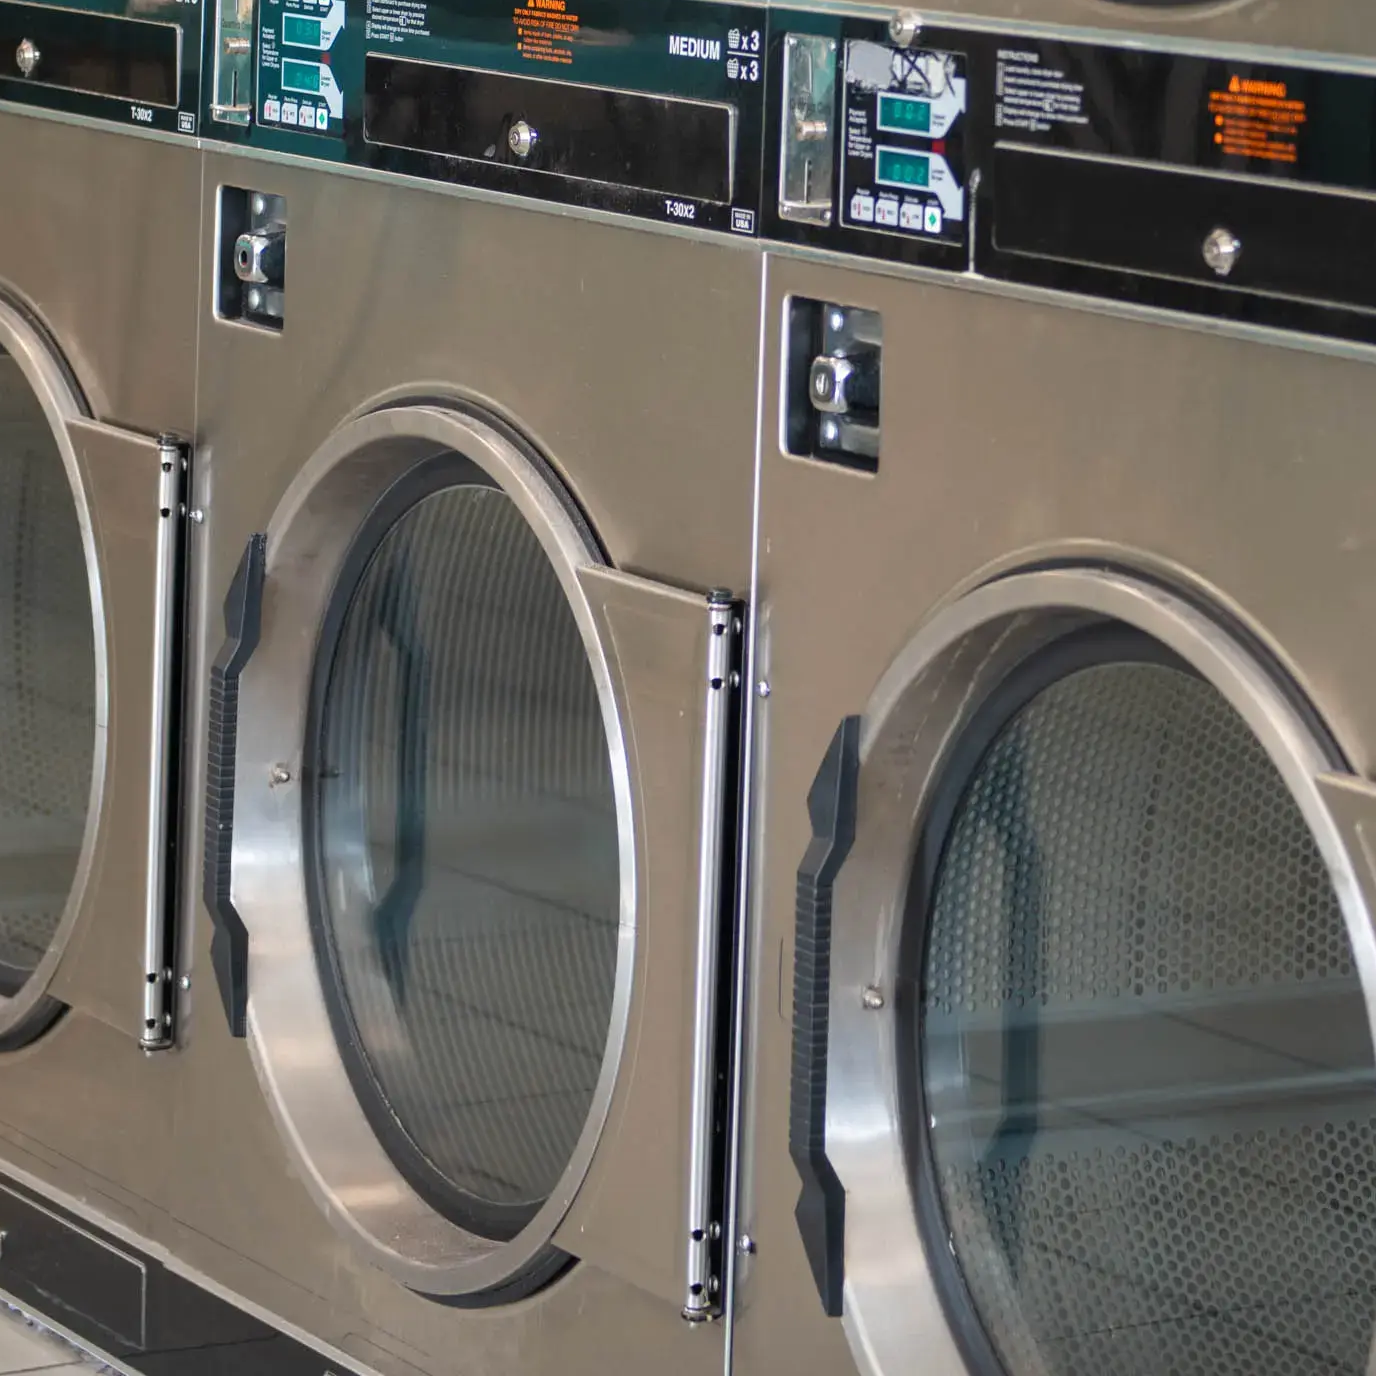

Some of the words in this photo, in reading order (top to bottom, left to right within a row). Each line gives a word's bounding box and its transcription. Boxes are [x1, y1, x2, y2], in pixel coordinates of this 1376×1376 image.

[669, 35, 721, 61] MEDIUM
[665, 199, 695, 219] T-30X2
[735, 219, 749, 229] USA
